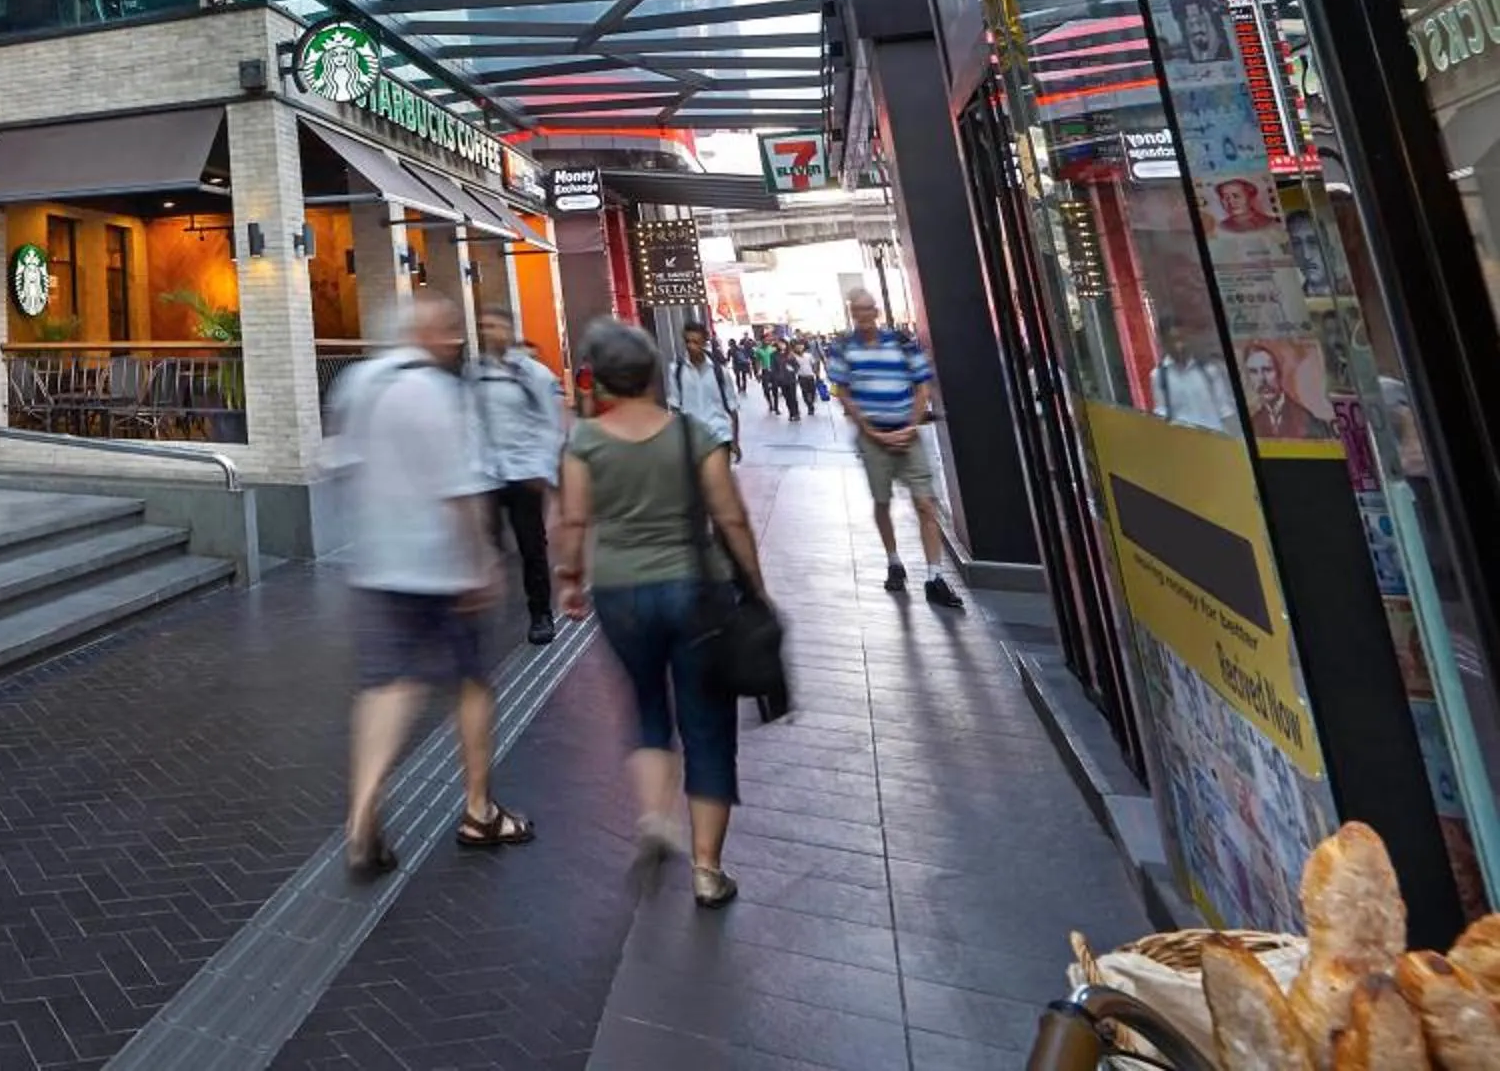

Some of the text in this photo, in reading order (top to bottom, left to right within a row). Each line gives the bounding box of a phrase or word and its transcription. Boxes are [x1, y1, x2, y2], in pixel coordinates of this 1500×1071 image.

[457, 120, 502, 175] COFFEE
[554, 170, 595, 184] Money
[774, 140, 818, 191] 7
[554, 182, 599, 196] Exchange
